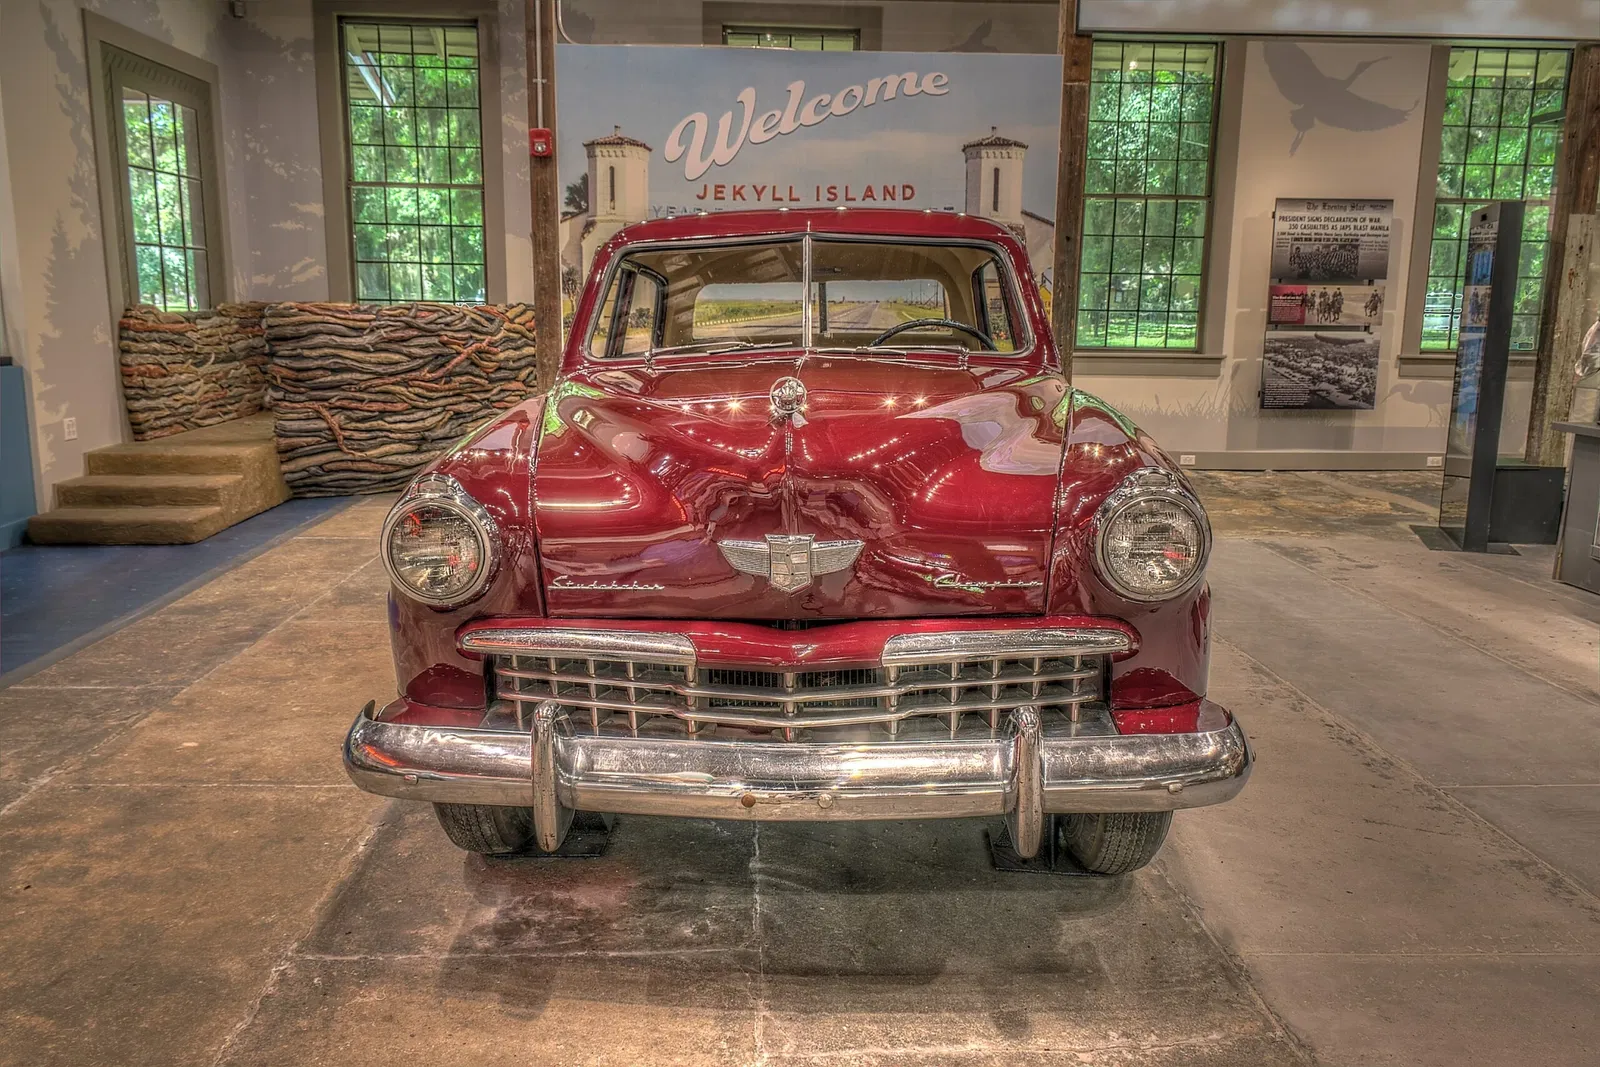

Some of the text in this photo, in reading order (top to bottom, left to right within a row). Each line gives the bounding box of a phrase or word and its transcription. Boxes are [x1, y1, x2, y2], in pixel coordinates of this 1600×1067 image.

[664, 71, 950, 182] Welcome
[696, 184, 916, 201] JEKYLL ISLAND
[1306, 201, 1319, 212] The
[1278, 215, 1306, 223] PRESIDENT
[1307, 215, 1323, 223] SIGNS
[1323, 216, 1358, 224] DECLARATION
[1359, 216, 1367, 224] OF
[1300, 224, 1330, 232] CASUALTIES
[1331, 224, 1338, 232] AS
[547, 575, 665, 591] Studebaker
